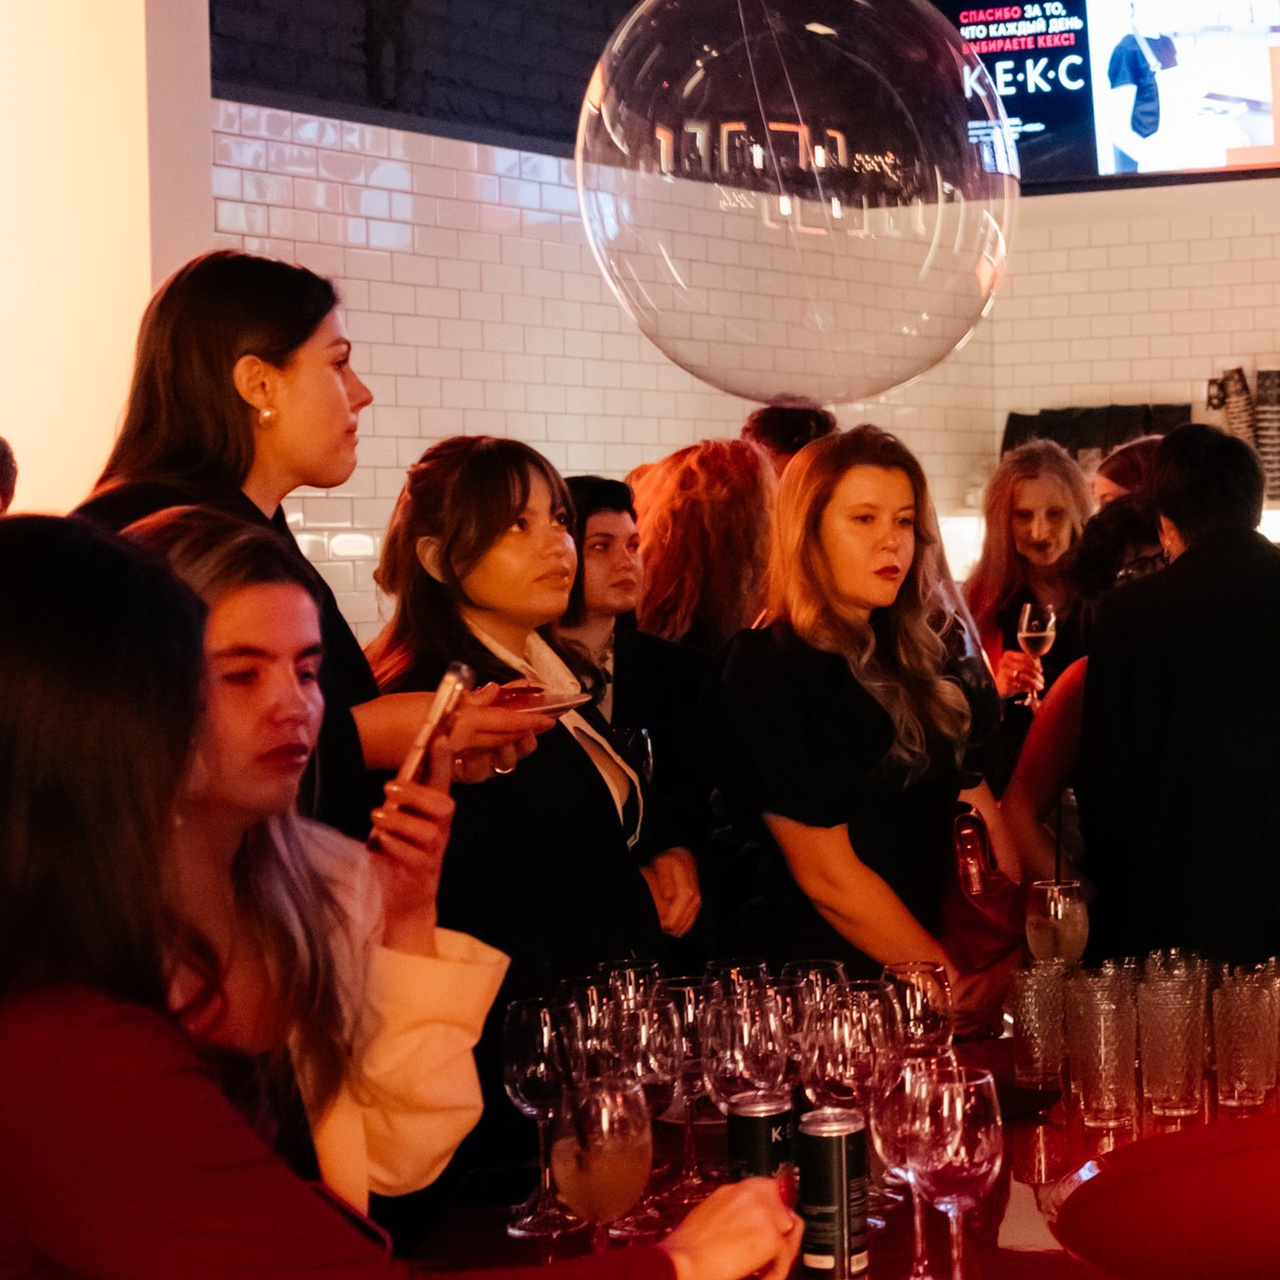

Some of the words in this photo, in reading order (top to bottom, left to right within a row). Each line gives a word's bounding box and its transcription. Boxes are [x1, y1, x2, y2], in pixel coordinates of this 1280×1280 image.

[959, 6, 1022, 23] СПАСИБО
[1024, 4, 1042, 18] ЗА
[1043, 2, 1067, 16] ТО,
[960, 25, 987, 39] ЧТО
[989, 17, 1047, 37] КАЖДЫЙ
[1048, 16, 1084, 33] ДЕНЬ
[962, 36, 1035, 54] ВЫБИРАЕТЕ
[1037, 32, 1075, 48] КЕКС!
